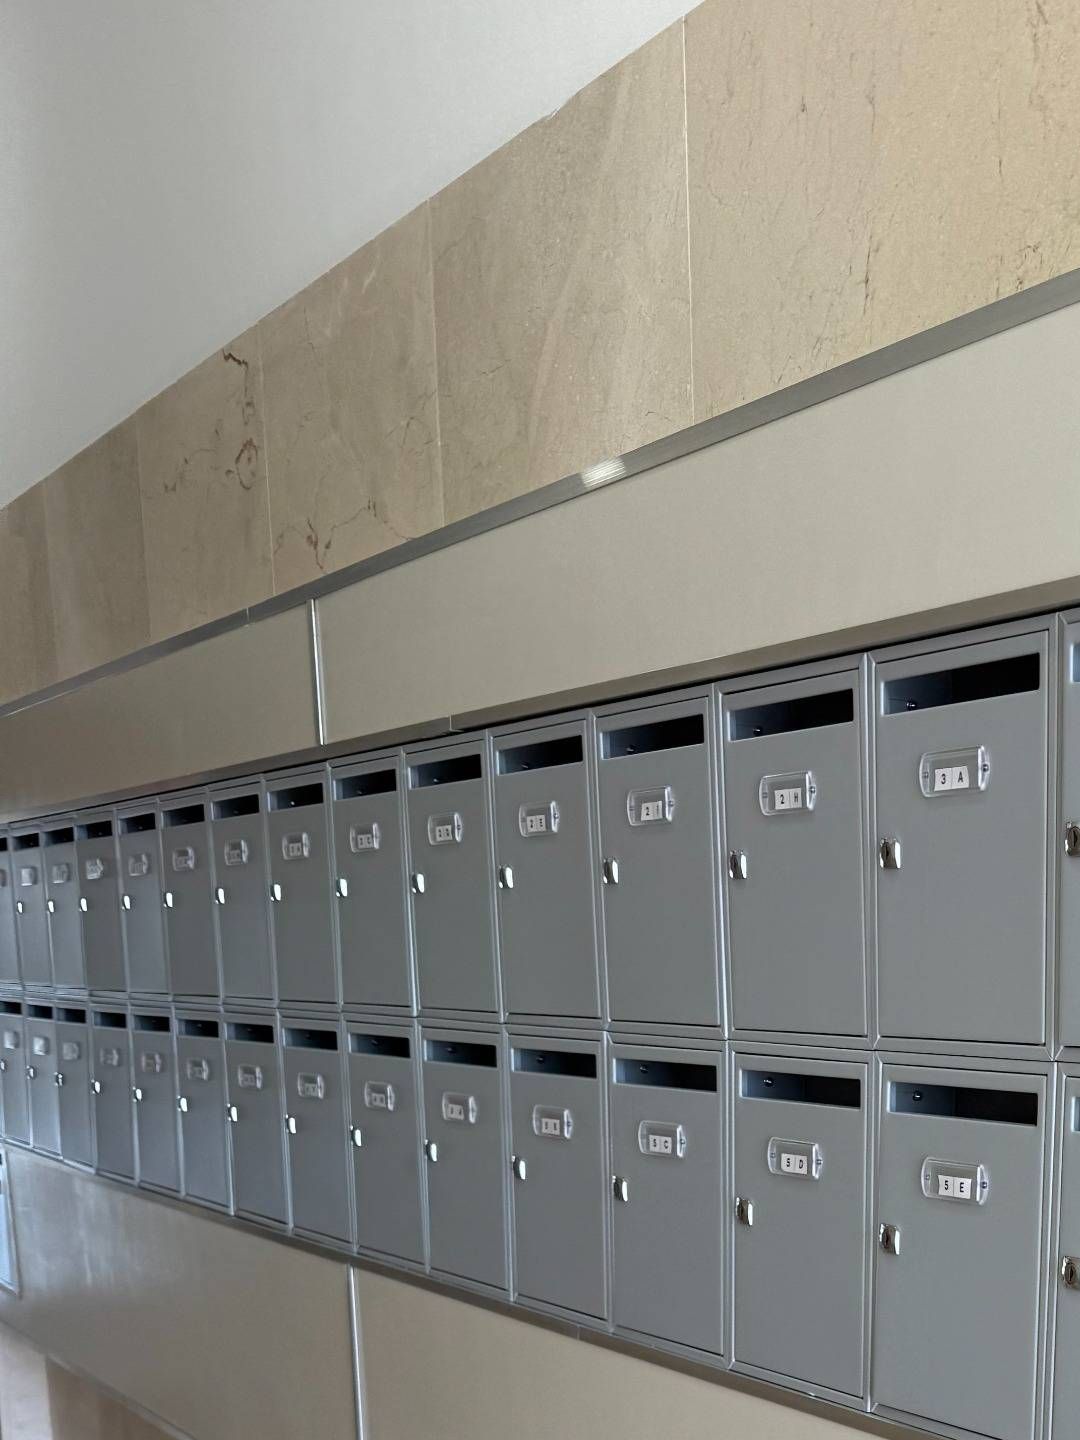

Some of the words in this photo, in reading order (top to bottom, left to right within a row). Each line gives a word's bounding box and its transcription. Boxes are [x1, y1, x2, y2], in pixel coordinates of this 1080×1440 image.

[940, 773, 946, 785] 3
[958, 771, 964, 783] A
[780, 794, 784, 804] 2
[786, 1158, 791, 1168] 5
[944, 1180, 949, 1191] 5
[960, 1182, 964, 1193] E
